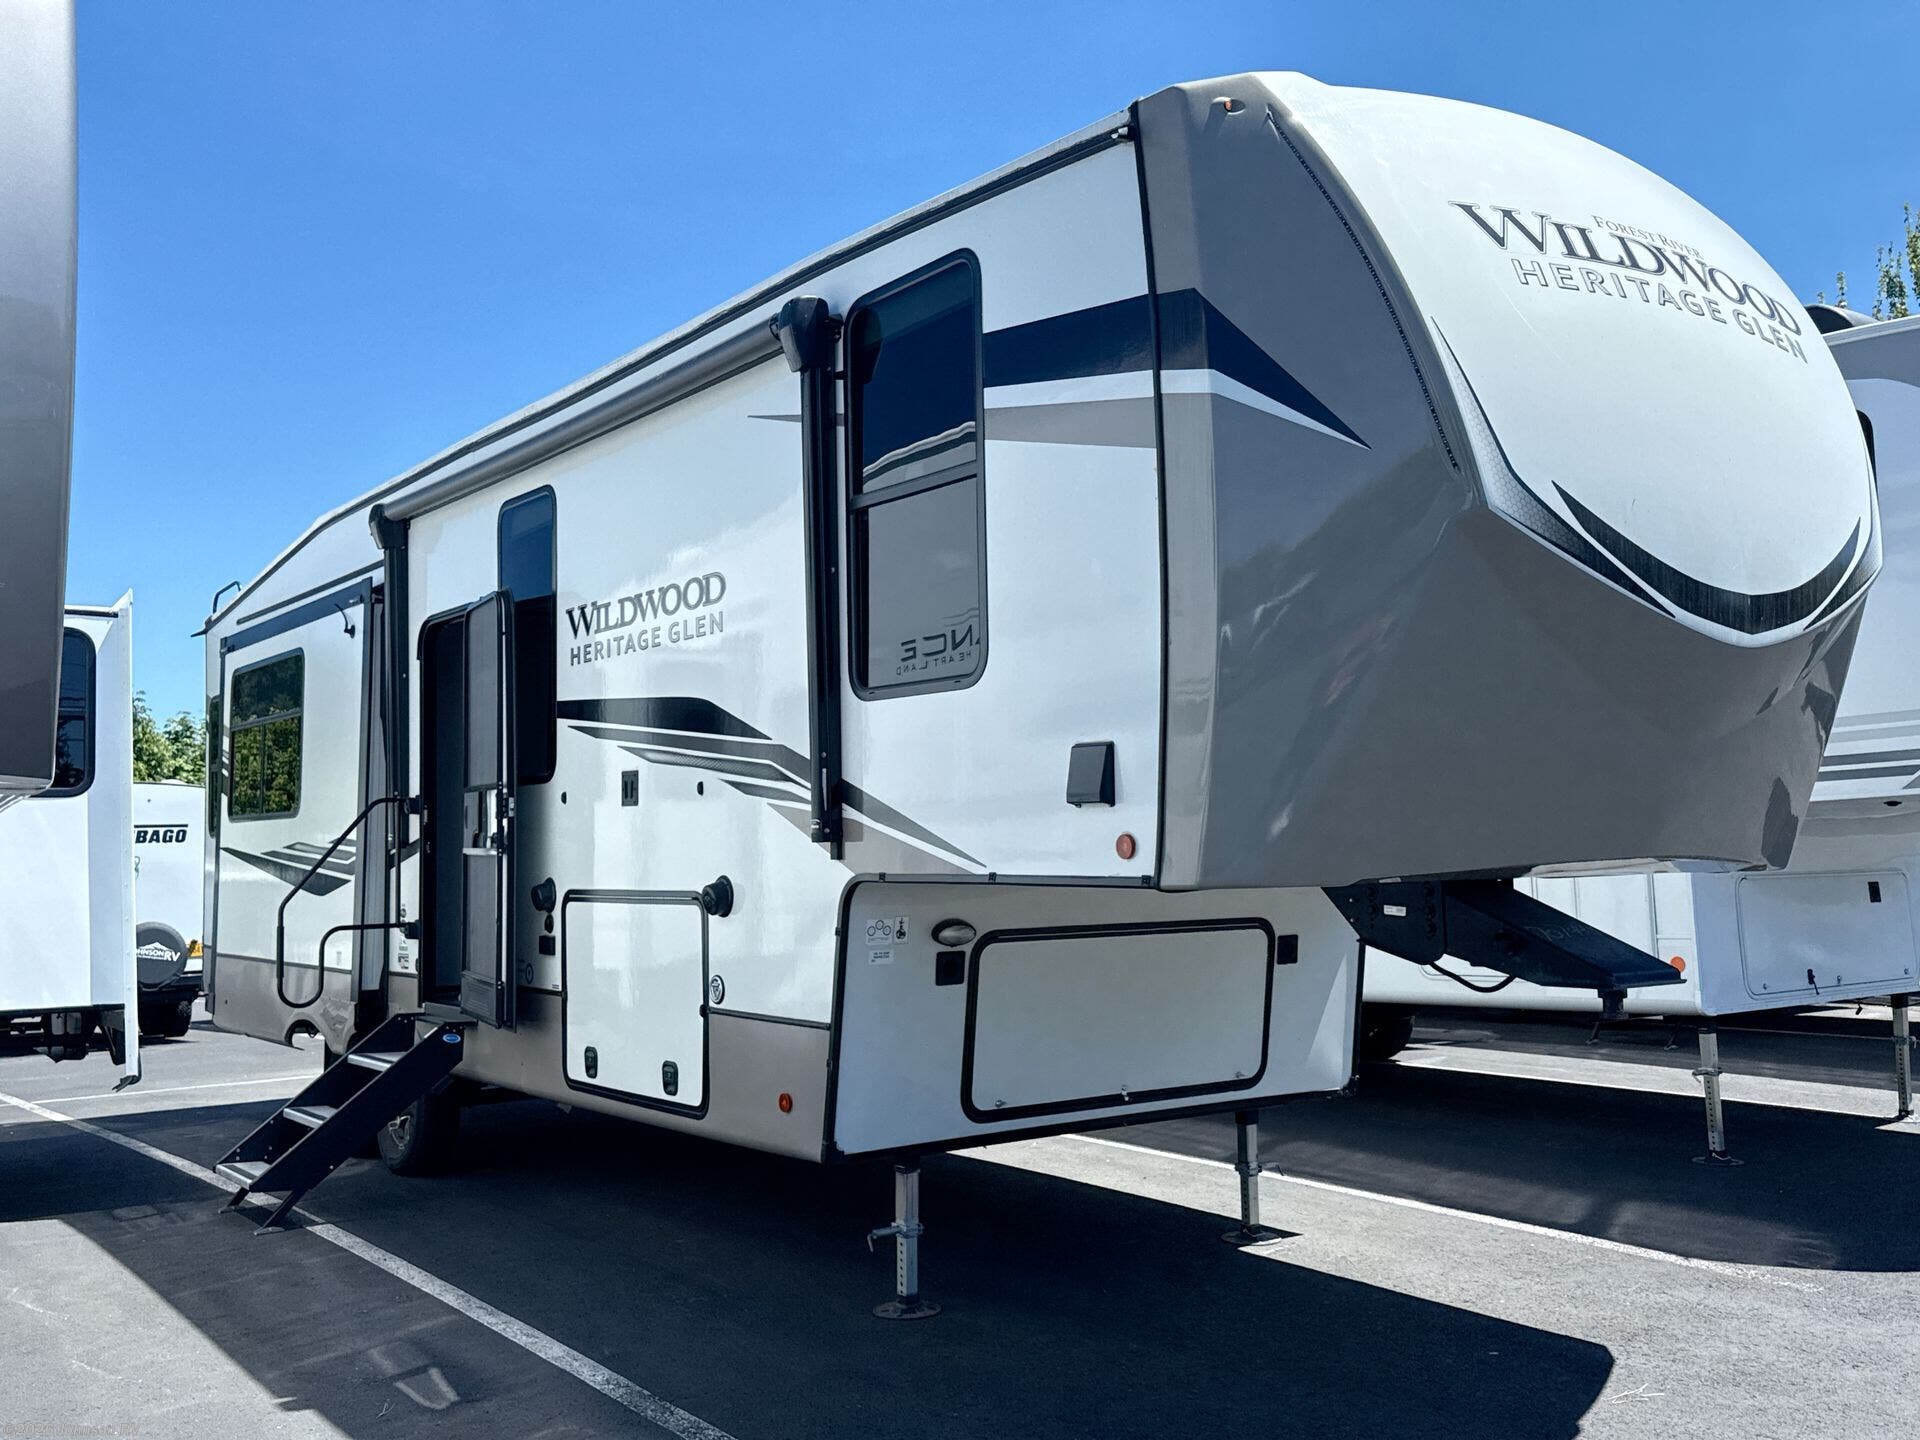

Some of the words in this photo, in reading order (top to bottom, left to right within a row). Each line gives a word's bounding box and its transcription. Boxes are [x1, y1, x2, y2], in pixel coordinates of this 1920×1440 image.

[1590, 214, 1656, 243] FOREST
[1656, 233, 1704, 261] RIVER
[1448, 201, 1801, 336] WILDWOOD
[1510, 258, 1727, 325] HERITAGE
[1732, 308, 1808, 364] GLEN
[565, 571, 727, 640] WILDWOOD
[570, 625, 662, 667] HERITAGE
[668, 611, 724, 644] GLEN
[134, 829, 188, 844] BAGO
[163, 950, 181, 962] RV
